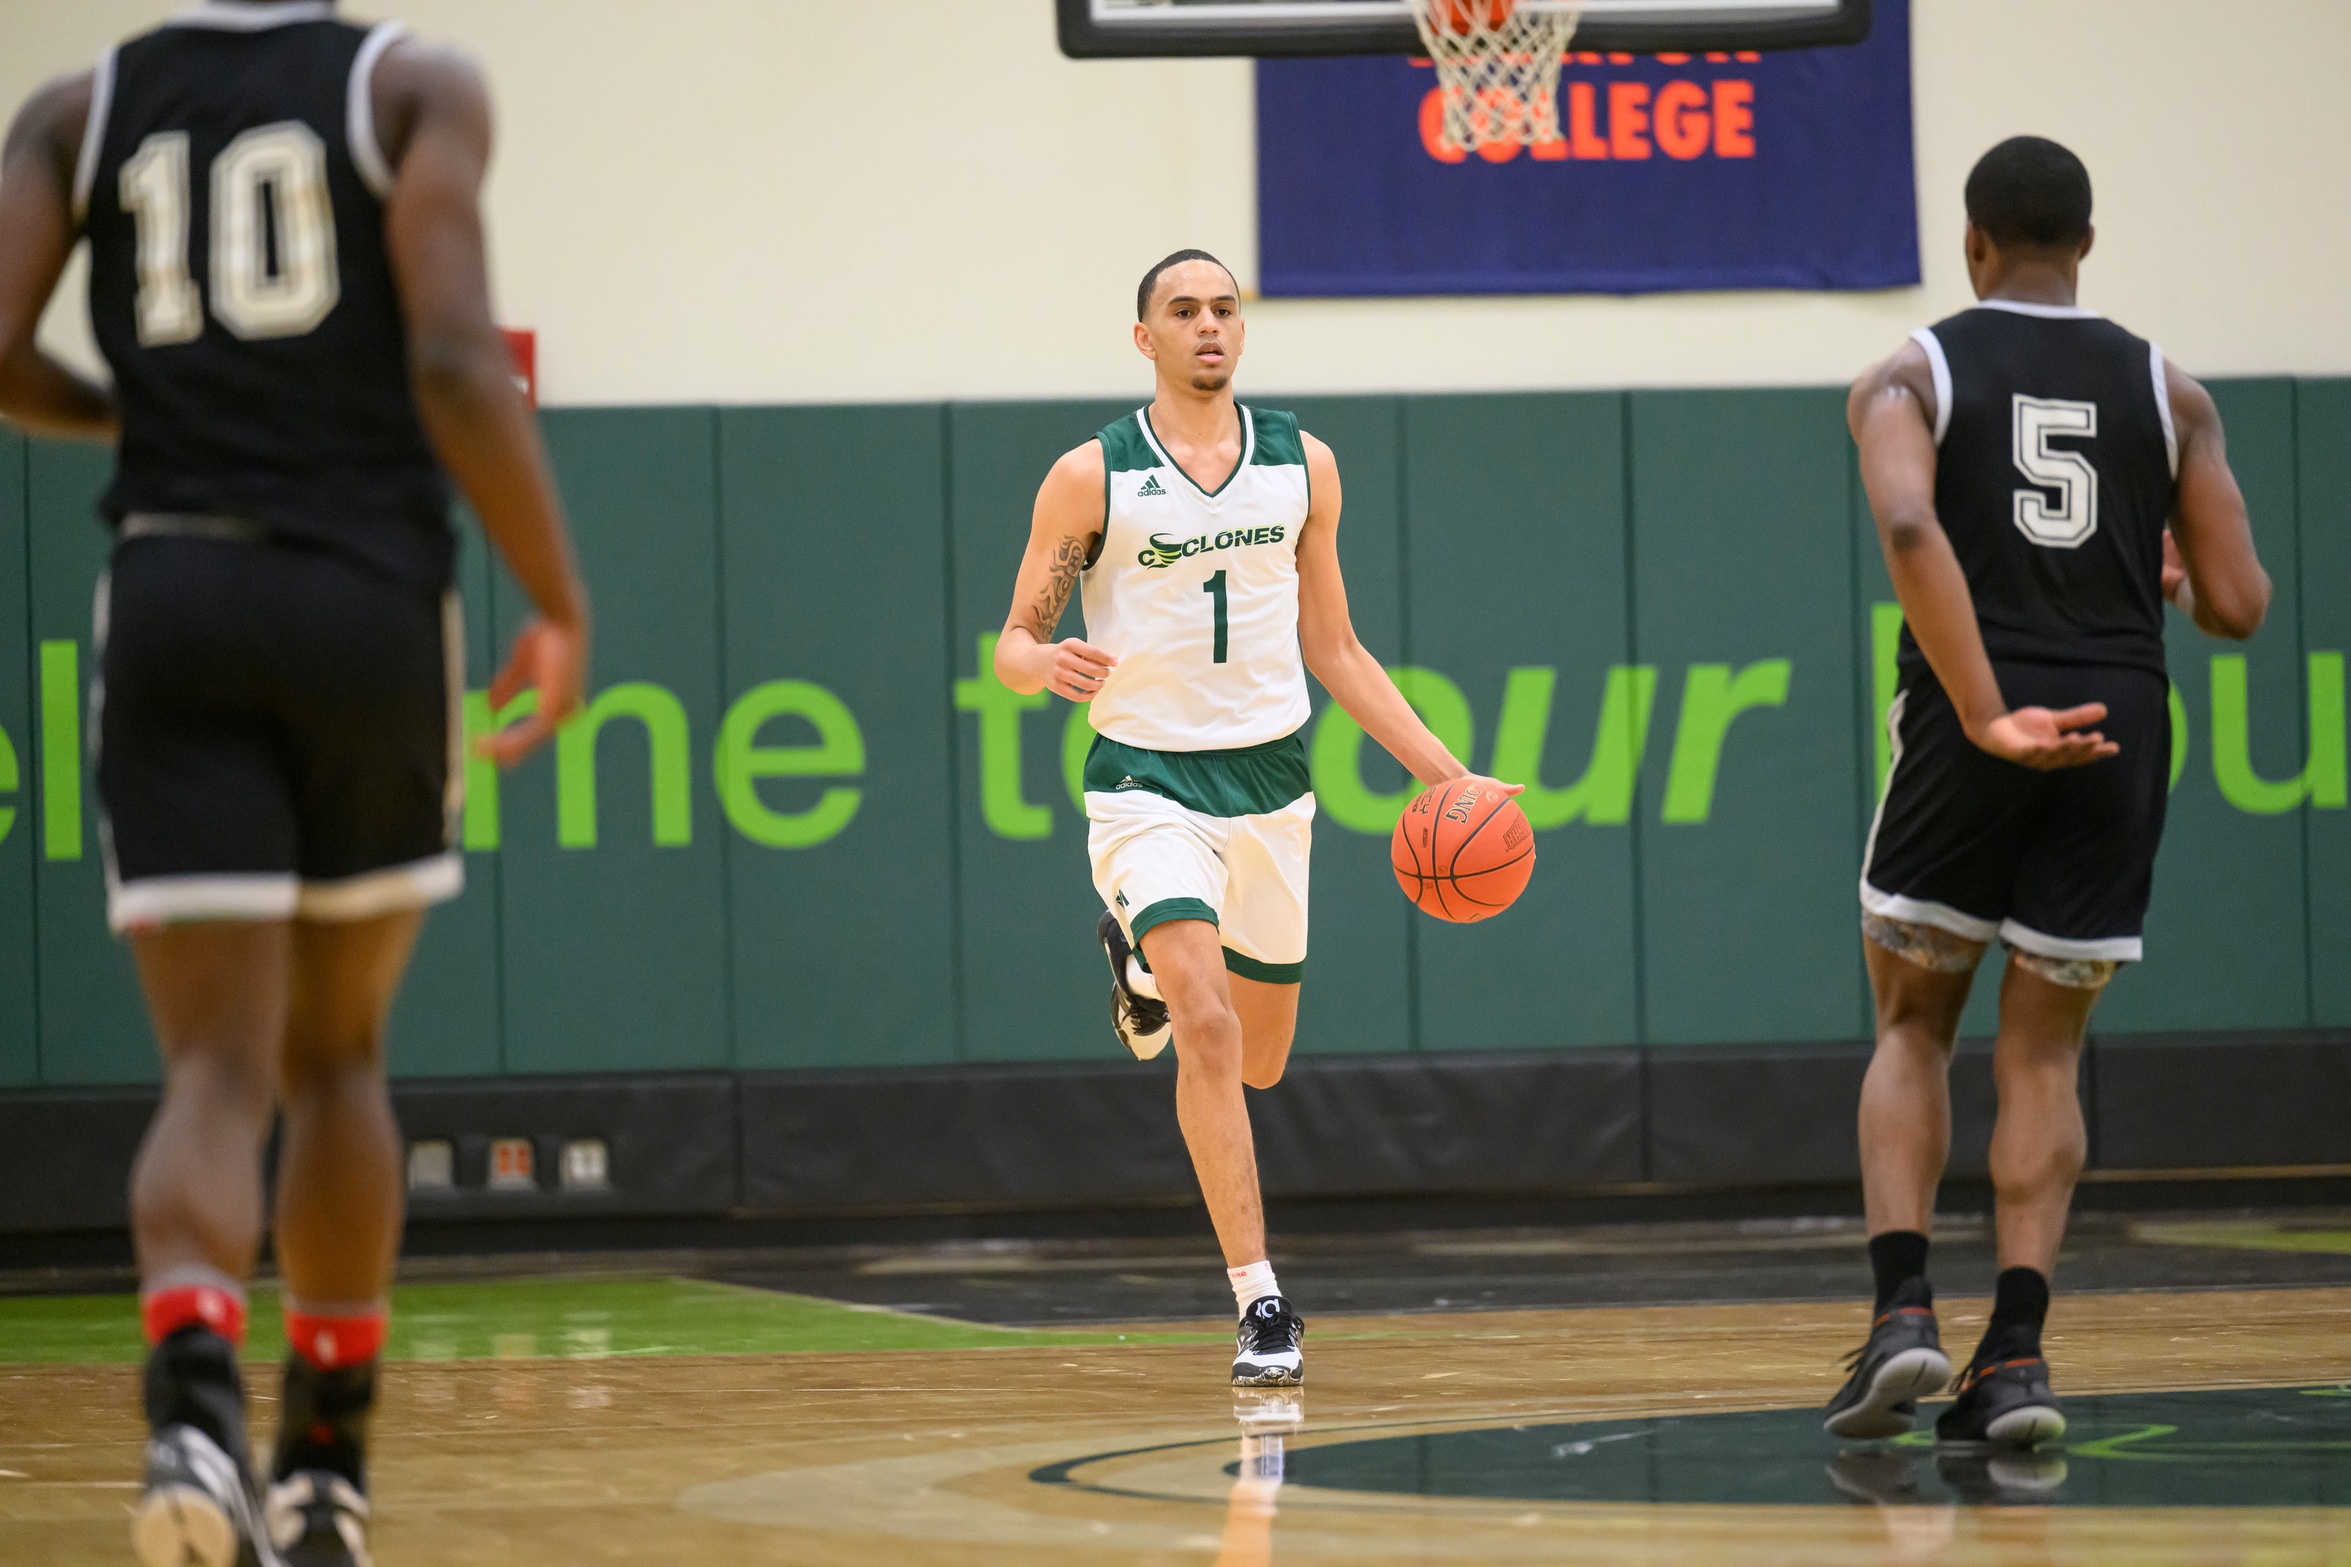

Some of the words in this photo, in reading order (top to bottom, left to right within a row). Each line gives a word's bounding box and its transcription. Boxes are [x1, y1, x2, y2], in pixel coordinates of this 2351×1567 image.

[118, 119, 341, 349] 10
[1137, 487, 1167, 497] adidas
[2012, 393, 2097, 548] 5
[1203, 569, 1228, 664] 1
[1115, 781, 1143, 790] adidas
